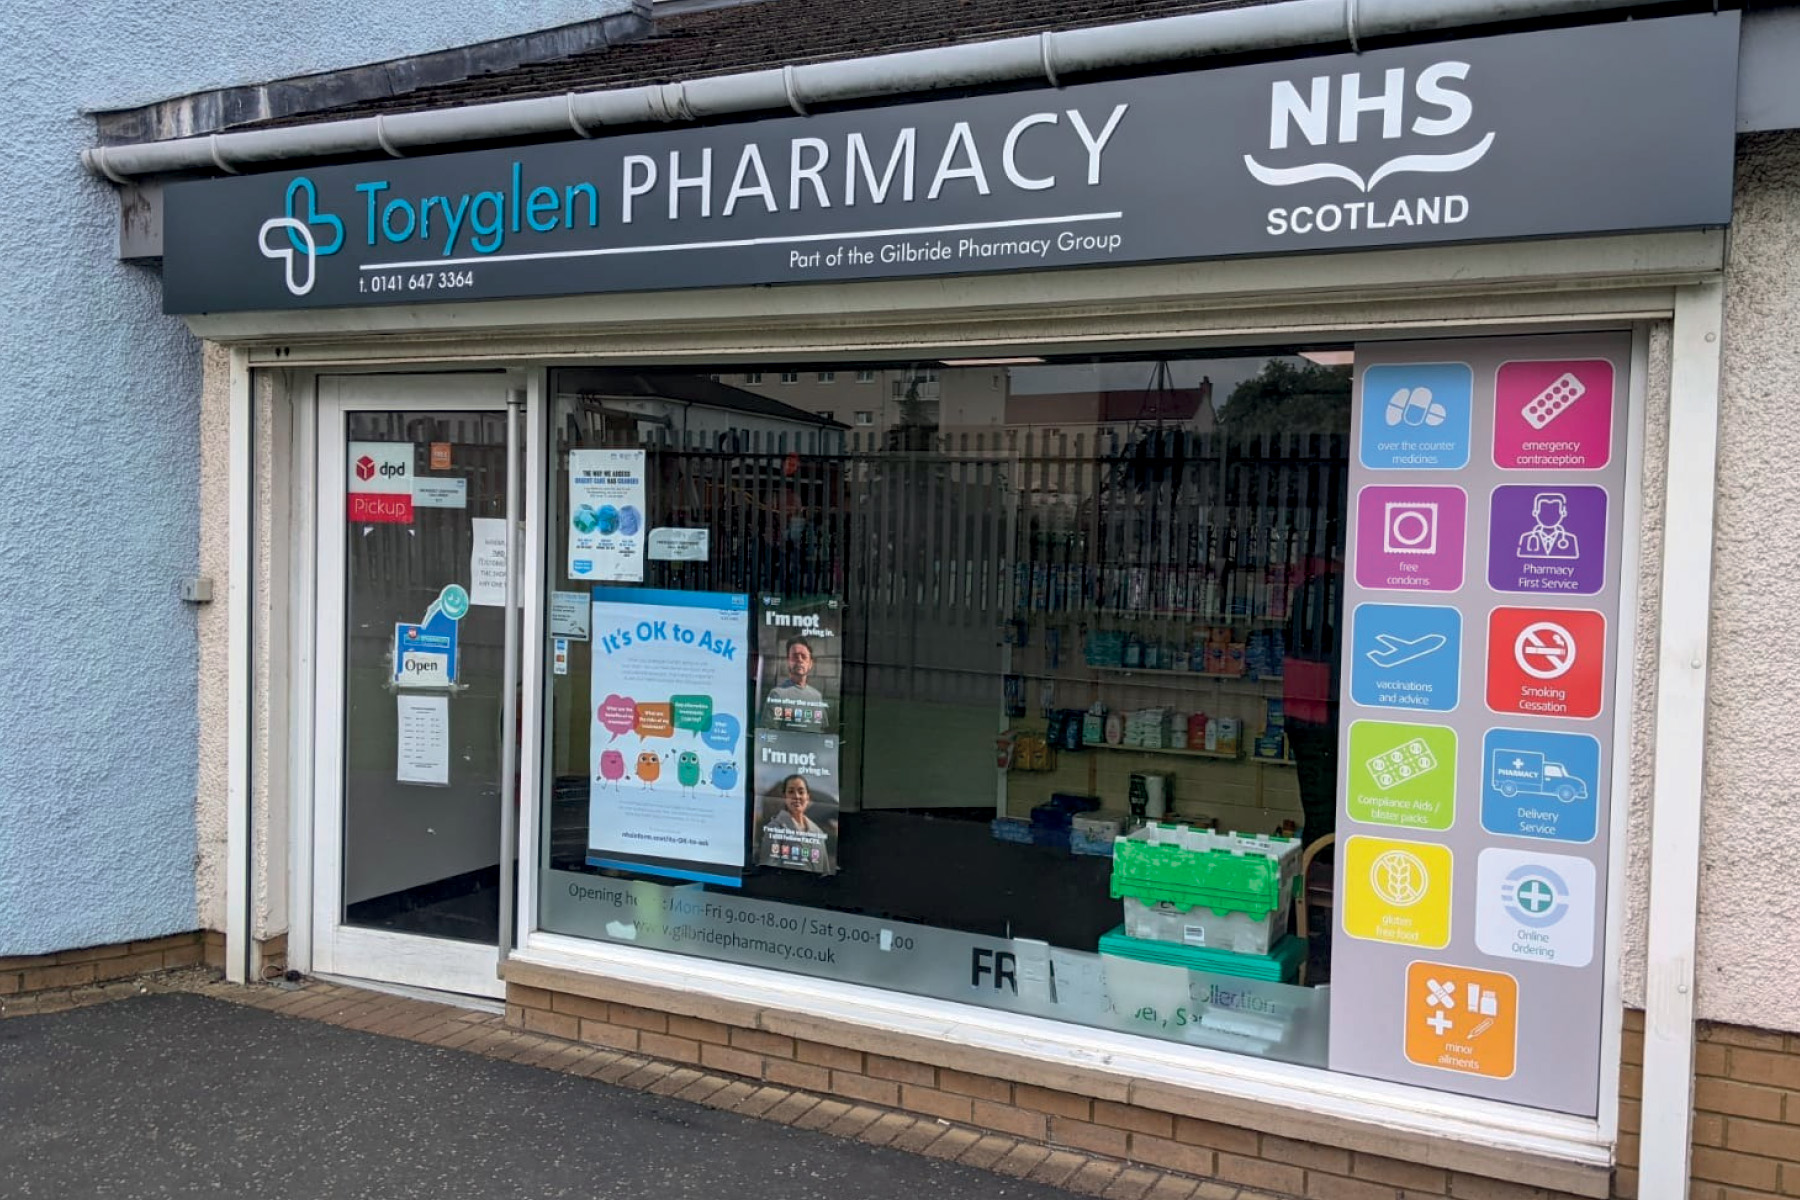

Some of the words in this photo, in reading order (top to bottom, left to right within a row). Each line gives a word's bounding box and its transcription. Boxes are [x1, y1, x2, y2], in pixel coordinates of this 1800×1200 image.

[1269, 60, 1474, 150] NHS
[355, 161, 599, 257] Toryglen
[622, 103, 1129, 224] PHARMACY
[1266, 194, 1470, 236] SCOTLAND
[789, 249, 821, 269] Part
[825, 246, 844, 267] of
[846, 245, 875, 265] the
[880, 240, 953, 263] Gilbride
[958, 234, 1050, 262] Pharmacy
[1057, 230, 1122, 255] Group
[358, 277, 368, 292] t.
[371, 274, 403, 292] 0141
[408, 273, 434, 290] 647
[438, 271, 474, 289] 3364
[1377, 441, 1400, 451] over
[1401, 440, 1418, 451] the
[1419, 441, 1456, 451] counter
[1522, 440, 1580, 453] emergency
[1392, 454, 1437, 464] medicines
[1516, 454, 1585, 467] contraception
[379, 461, 406, 479] dpd
[354, 498, 406, 517] Pickup
[1399, 561, 1419, 572] free
[1523, 563, 1574, 577] Pharmacy
[1386, 574, 1430, 585] condoms
[1518, 577, 1540, 588] First
[1541, 578, 1579, 590] Service
[765, 610, 791, 627] I'm
[792, 613, 819, 628] not
[600, 627, 633, 656] It's
[636, 620, 667, 642] OK
[672, 625, 695, 642] to
[697, 628, 737, 661] Ask
[801, 628, 825, 638] giving
[404, 659, 438, 675] Open
[1376, 680, 1433, 692] vaccinations
[1521, 685, 1566, 700] Smoking
[1378, 693, 1398, 703] and
[1399, 694, 1430, 706] advice
[1519, 700, 1567, 713] Cessation
[762, 747, 787, 764] I'm
[789, 751, 816, 767] not
[1497, 768, 1539, 779] PHARMACY
[1357, 795, 1411, 812] Compliance
[1413, 798, 1433, 810] Aids
[1517, 808, 1559, 823] Delivery
[1519, 822, 1557, 835] Service
[568, 882, 623, 908] Opening
[669, 898, 722, 919] Mon-Fri
[725, 908, 799, 932] 9.00-18.00
[801, 917, 807, 935] /
[810, 920, 833, 937] Sat
[837, 927, 914, 950] 9.00-1.00
[633, 919, 836, 964] ww.gilbridepharmacy.co.uk
[1516, 929, 1550, 943] Online
[1511, 942, 1555, 957] Ordering
[1445, 1041, 1473, 1055] minor
[1438, 1054, 1480, 1070] ailments
